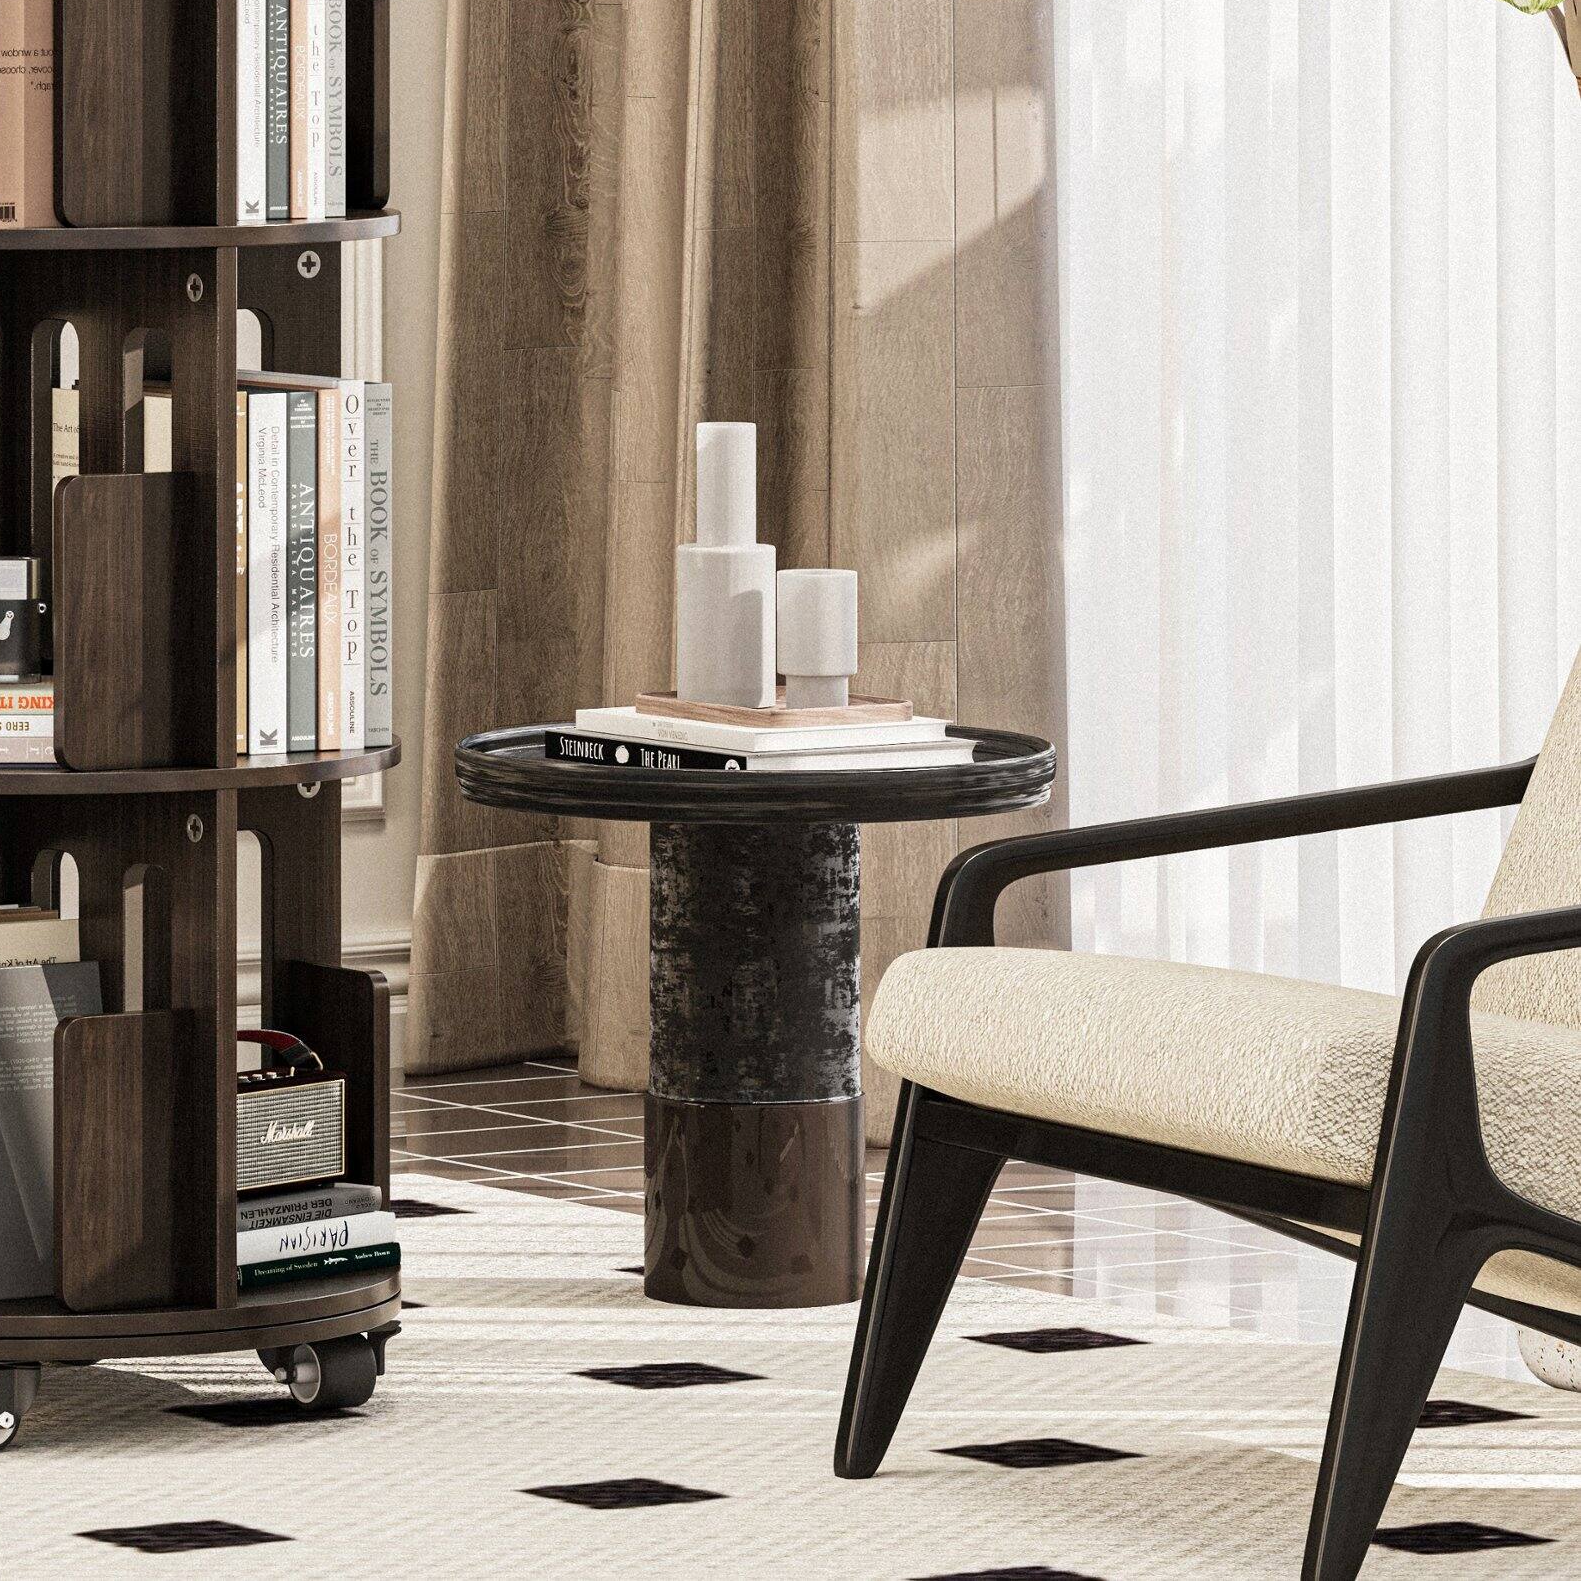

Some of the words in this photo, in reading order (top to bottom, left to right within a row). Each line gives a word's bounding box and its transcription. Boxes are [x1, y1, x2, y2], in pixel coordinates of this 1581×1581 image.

[274, 3, 288, 145] ANTIQUAIRES
[328, 76, 343, 177] SYMBOLS
[256, 428, 267, 465] Virginia
[270, 426, 280, 455] Detail
[345, 394, 359, 477] Over
[370, 439, 379, 465] THE
[271, 457, 280, 467] in
[258, 468, 267, 509] McLeod
[269, 469, 280, 541] Contemporary
[370, 470, 388, 543] BOOK
[347, 506, 357, 566] the
[271, 544, 281, 600] Residential
[298, 482, 315, 658] ANTIQUAIRES
[370, 548, 379, 565] OF
[323, 533, 338, 627] BORDEAUX
[270, 602, 280, 664] Architecture
[346, 590, 359, 661] Top
[370, 570, 388, 696] SYMBOLS
[17, 696, 55, 710] KING
[5, 721, 30, 732] EERO
[559, 736, 604, 761] STEINBECK
[260, 1120, 315, 1145] Marshall
[240, 1200, 309, 1220] PRIMZAHLEN
[248, 1211, 313, 1230] EINSAMKEIT
[311, 1197, 332, 1209] DER
[314, 1208, 332, 1218] DIE
[279, 1220, 349, 1253] PARISIAN
[254, 1266, 286, 1277] Dreaming
[285, 1263, 294, 1273] of
[293, 1261, 318, 1271] Sweden
